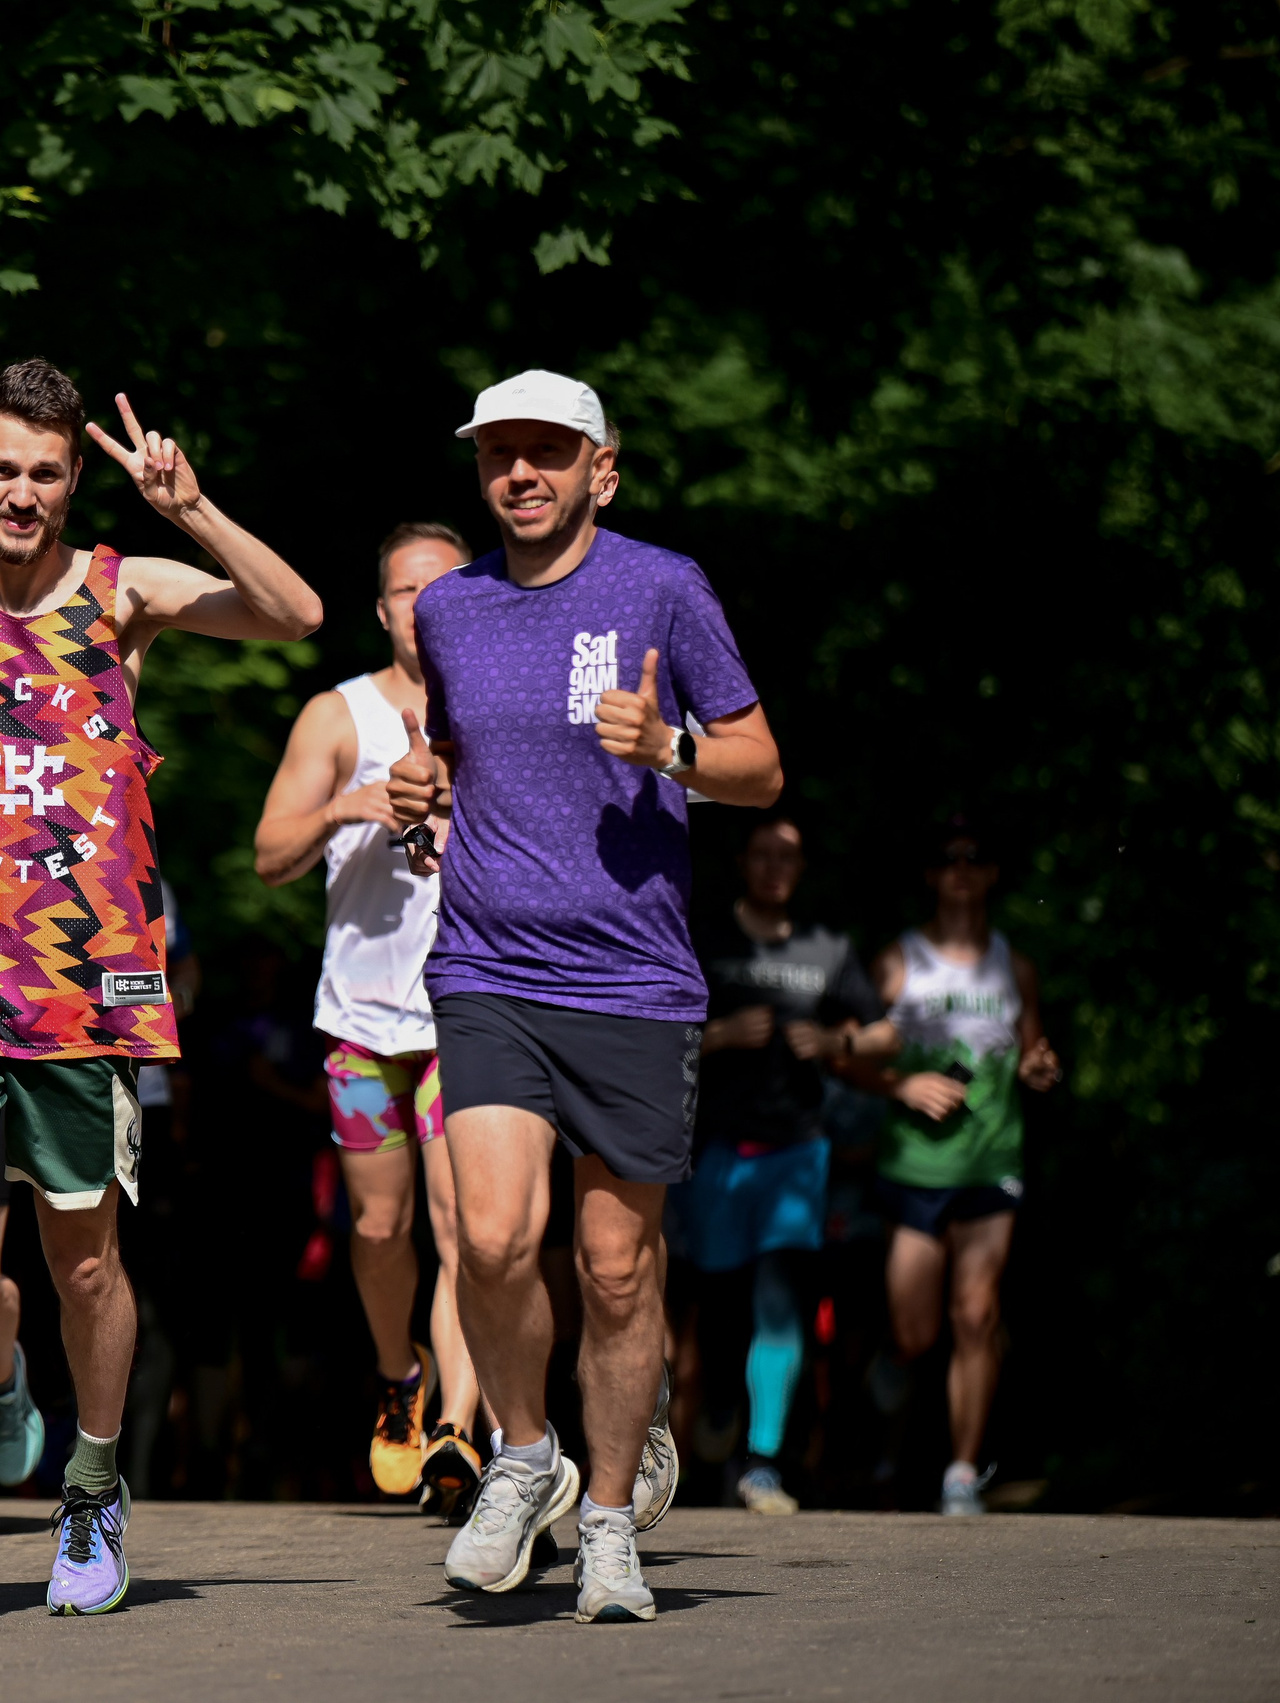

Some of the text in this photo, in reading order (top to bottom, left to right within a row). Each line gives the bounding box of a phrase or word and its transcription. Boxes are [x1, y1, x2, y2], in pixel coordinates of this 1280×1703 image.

[572, 630, 618, 668] Sat
[569, 664, 618, 695] 9AM
[567, 694, 600, 725] 5K
